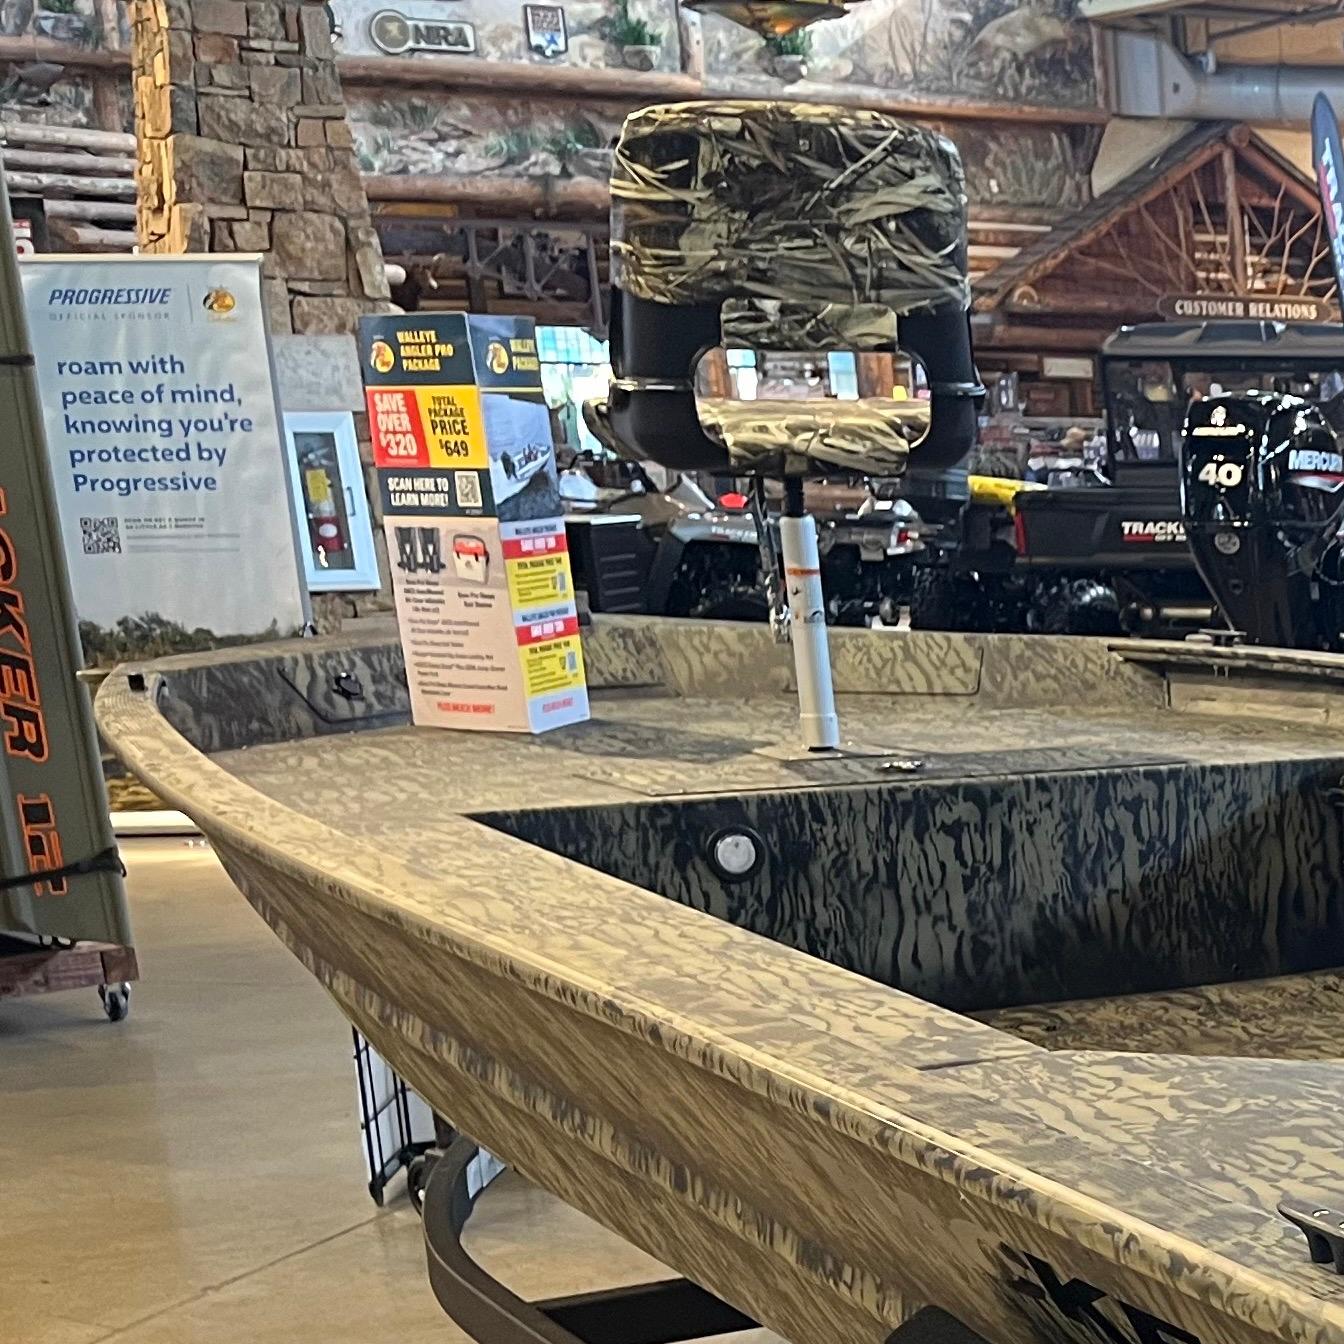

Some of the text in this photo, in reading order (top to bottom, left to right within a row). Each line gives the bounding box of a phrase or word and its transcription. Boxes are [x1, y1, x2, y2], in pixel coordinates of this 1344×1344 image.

[413, 24, 470, 47] NRA
[49, 288, 171, 306] PROGRESSIVE
[1174, 299, 1318, 320] CUSTOMER RELATIONS
[397, 330, 437, 344] WALLEYE
[400, 344, 454, 358] ANGLER PRO
[57, 354, 185, 375] roam with
[403, 358, 441, 371] PACKAGE
[61, 384, 242, 410] peace of mind,
[374, 393, 407, 413] SAVE
[432, 396, 457, 407] TOTAL
[428, 407, 465, 418] PACKAGE
[64, 413, 253, 437] knowing you're
[377, 413, 411, 433] OVER
[431, 420, 469, 436] PRICE
[69, 443, 227, 468] protected by
[379, 434, 418, 457] $320
[439, 439, 469, 458] $649
[73, 472, 217, 496] Progressive
[1198, 461, 1245, 487] 40
[388, 478, 449, 492] SCAN HERE TO
[391, 493, 449, 508] LEARN MORE!
